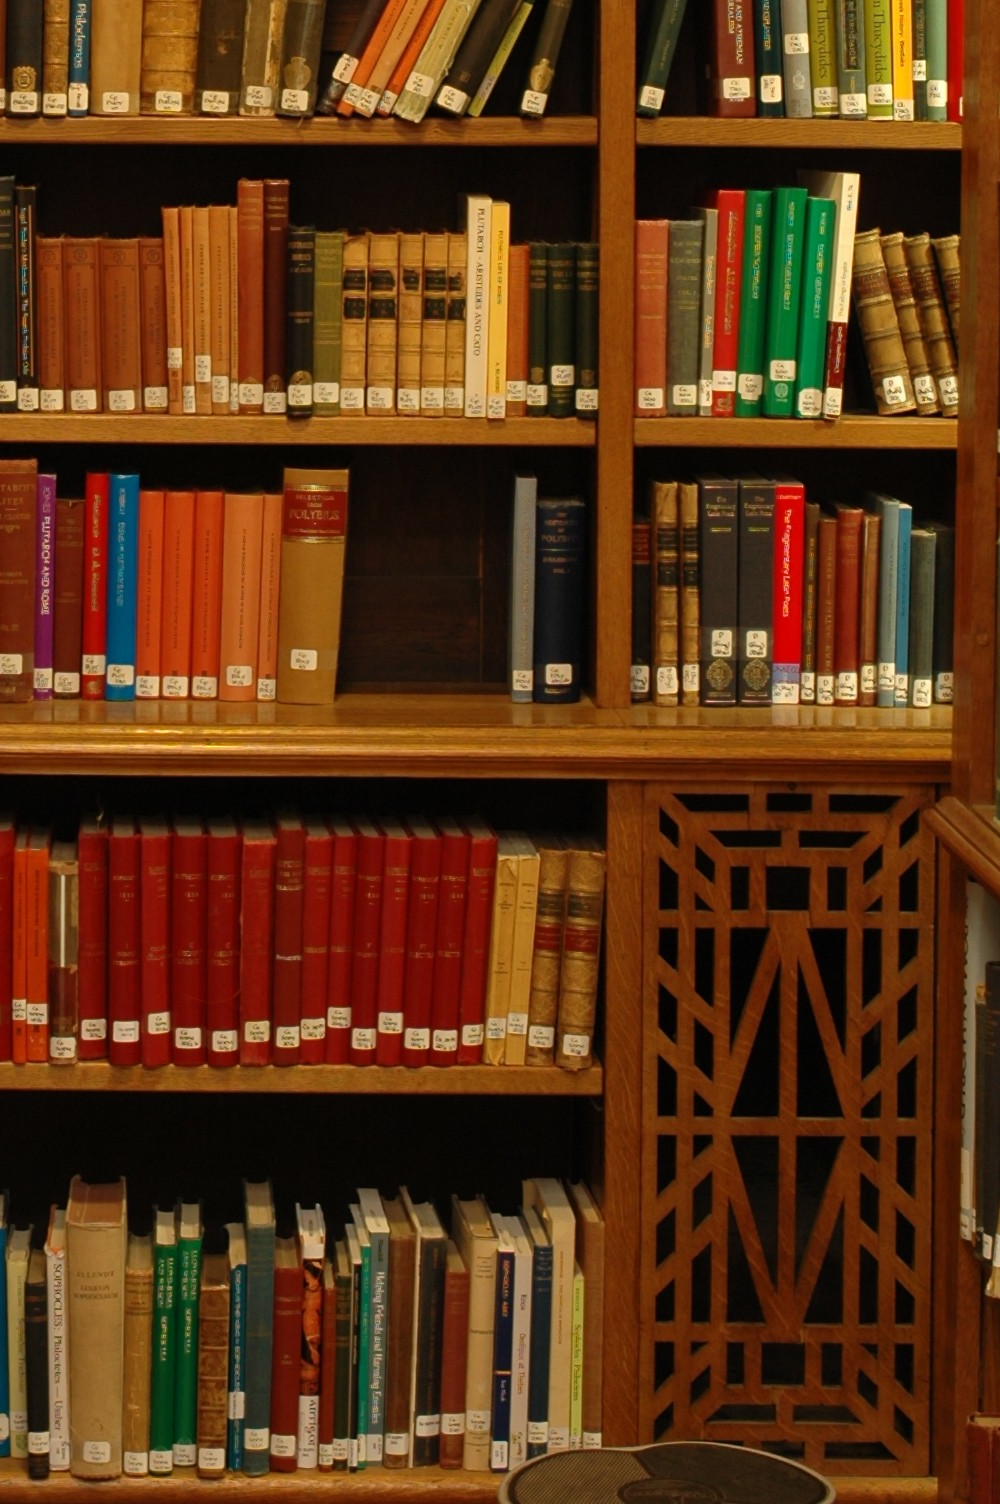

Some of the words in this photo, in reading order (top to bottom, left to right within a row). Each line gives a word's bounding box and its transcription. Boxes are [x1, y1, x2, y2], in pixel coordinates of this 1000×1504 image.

[735, 4, 743, 21] AND
[813, 7, 829, 79] Thucydides
[870, 11, 887, 83] Thucydides
[475, 207, 486, 254] PLUTARCH
[473, 311, 482, 332] AND
[471, 333, 481, 357] CATO
[288, 508, 340, 521] POLYBIUS
[784, 508, 794, 523] The
[40, 515, 52, 564] PLUTARCH
[40, 565, 52, 587] AND
[782, 575, 792, 596] Latin
[39, 587, 51, 616] ROME
[781, 596, 791, 619] Poets
[52, 1262, 64, 1330] SOPHOCLES:
[372, 1271, 386, 1303] Helping
[374, 1304, 386, 1335] Friends
[374, 1336, 384, 1351] and
[516, 1332, 528, 1361] Oedipus
[53, 1334, 64, 1384] Philoctetes
[371, 1353, 384, 1389] Harming
[371, 1390, 383, 1425] Enemies
